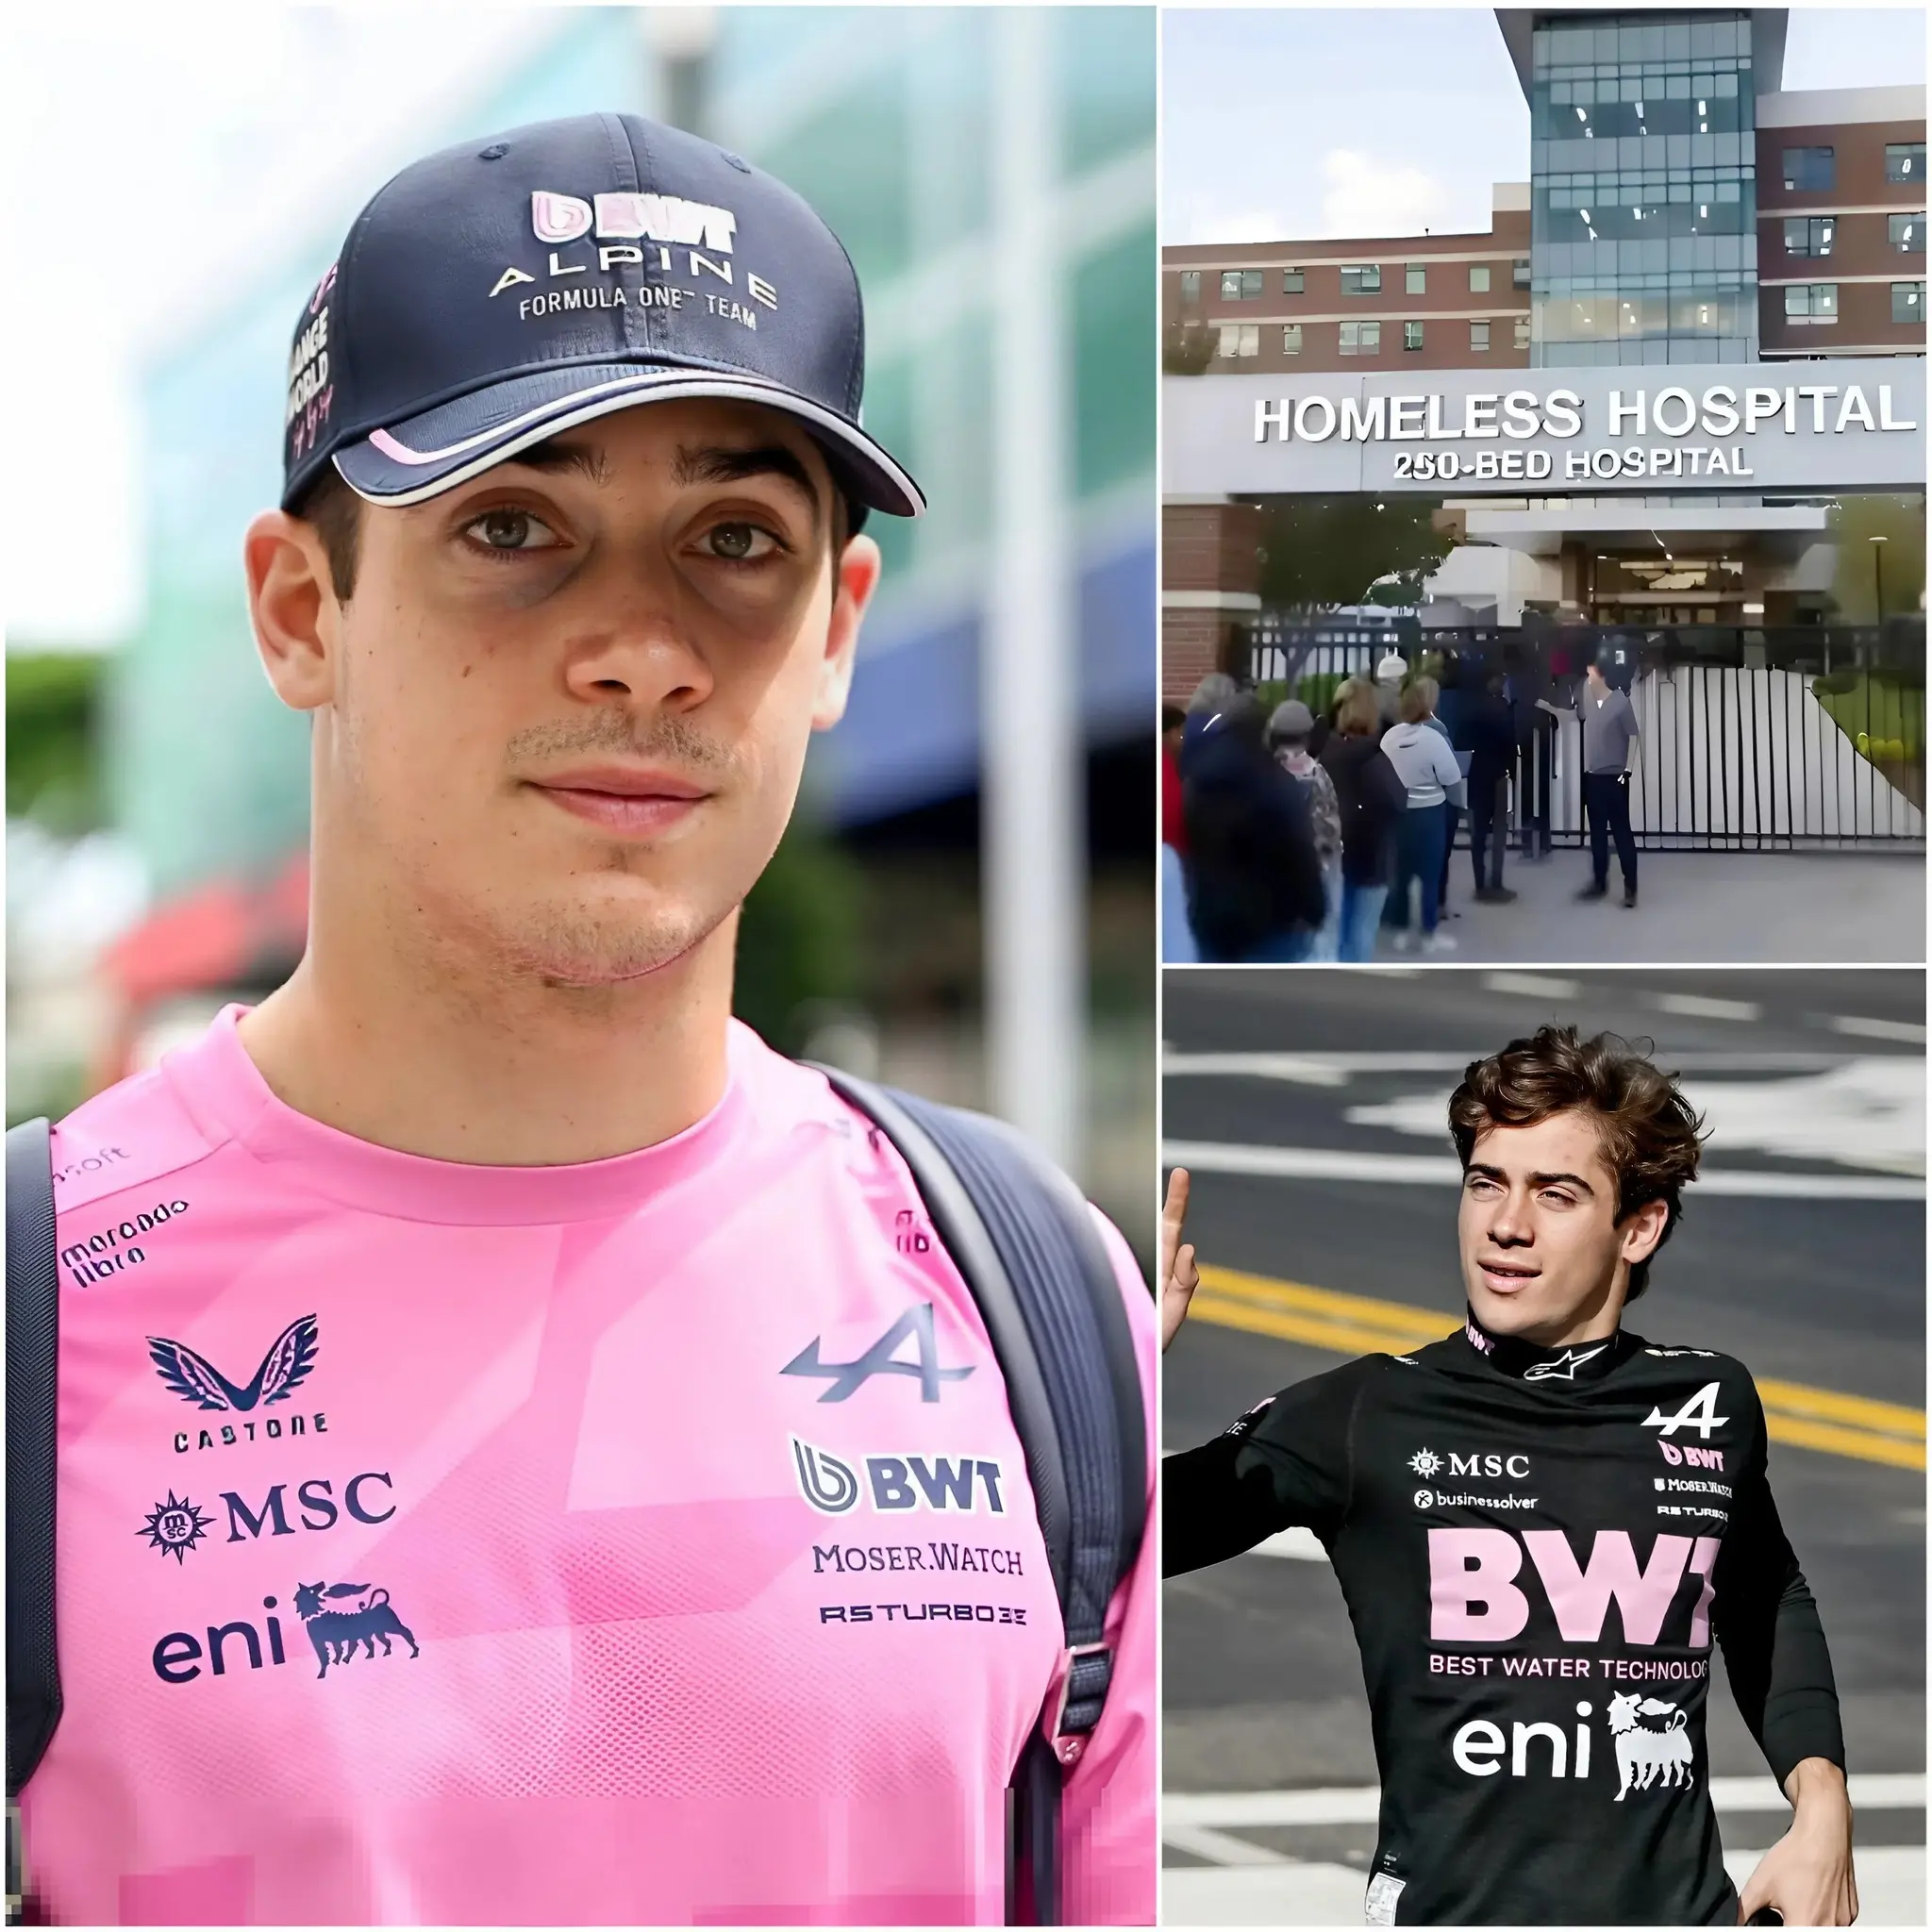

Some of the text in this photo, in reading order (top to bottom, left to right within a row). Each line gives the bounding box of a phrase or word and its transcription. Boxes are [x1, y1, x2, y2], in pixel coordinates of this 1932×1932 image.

[489, 246, 778, 311] ALPINE
[520, 287, 627, 321] FORMULA
[706, 293, 757, 330] TEAM
[291, 307, 329, 375] ANGE
[1254, 385, 1918, 442] HOMELESS HOSPITAL
[1392, 446, 1754, 480] 250-BED HOSPITAL
[865, 1457, 1004, 1513] BWT
[1448, 1453, 1529, 1478] MSC
[1683, 1446, 1724, 1472] BWT
[219, 1472, 397, 1543] MSC
[1437, 1491, 1540, 1509] businessolver
[1427, 1528, 1721, 1648] BWT
[153, 1595, 286, 1684] eni
[1429, 1655, 1493, 1676] BEST
[1502, 1657, 1591, 1677] WATER
[1453, 1701, 1592, 1778] eni
